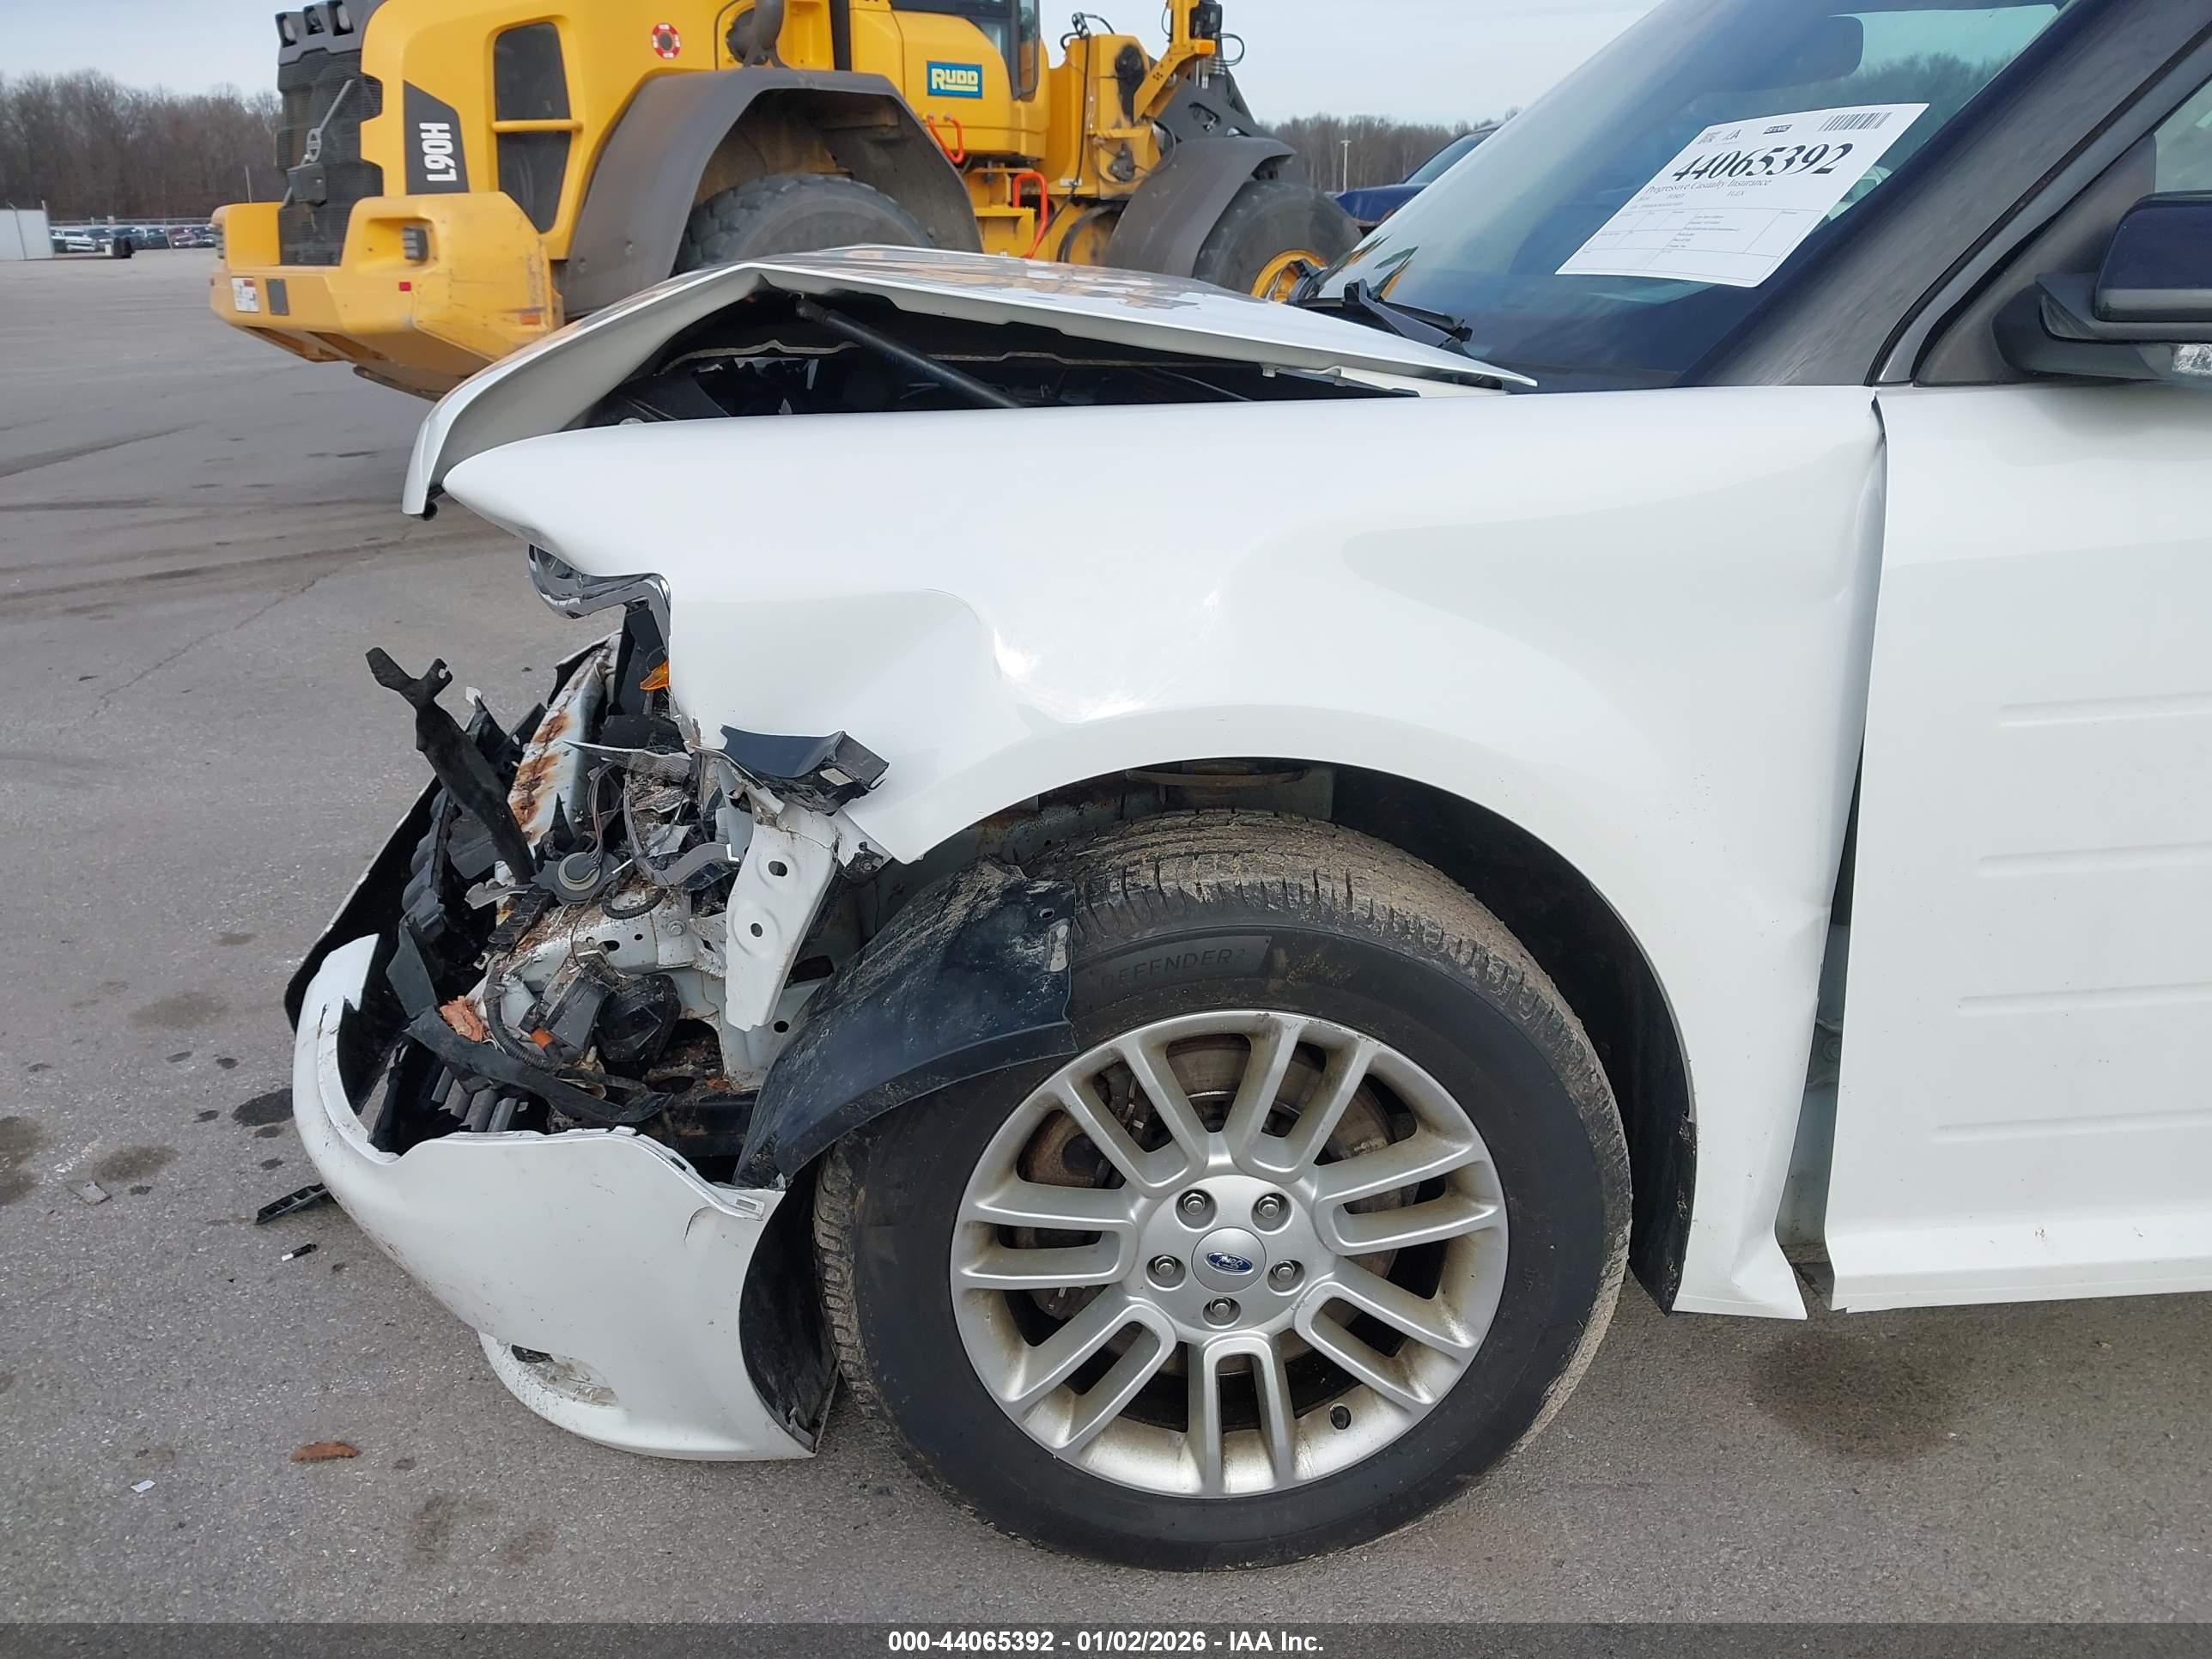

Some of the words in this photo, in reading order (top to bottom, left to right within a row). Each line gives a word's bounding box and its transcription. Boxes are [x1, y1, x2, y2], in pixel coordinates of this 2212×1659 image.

[931, 68, 979, 92] RUDD
[419, 122, 458, 181] L90H
[1672, 143, 1853, 182] 44065392
[1645, 183, 1690, 193] Progressive
[1727, 178, 1771, 187] Insurance
